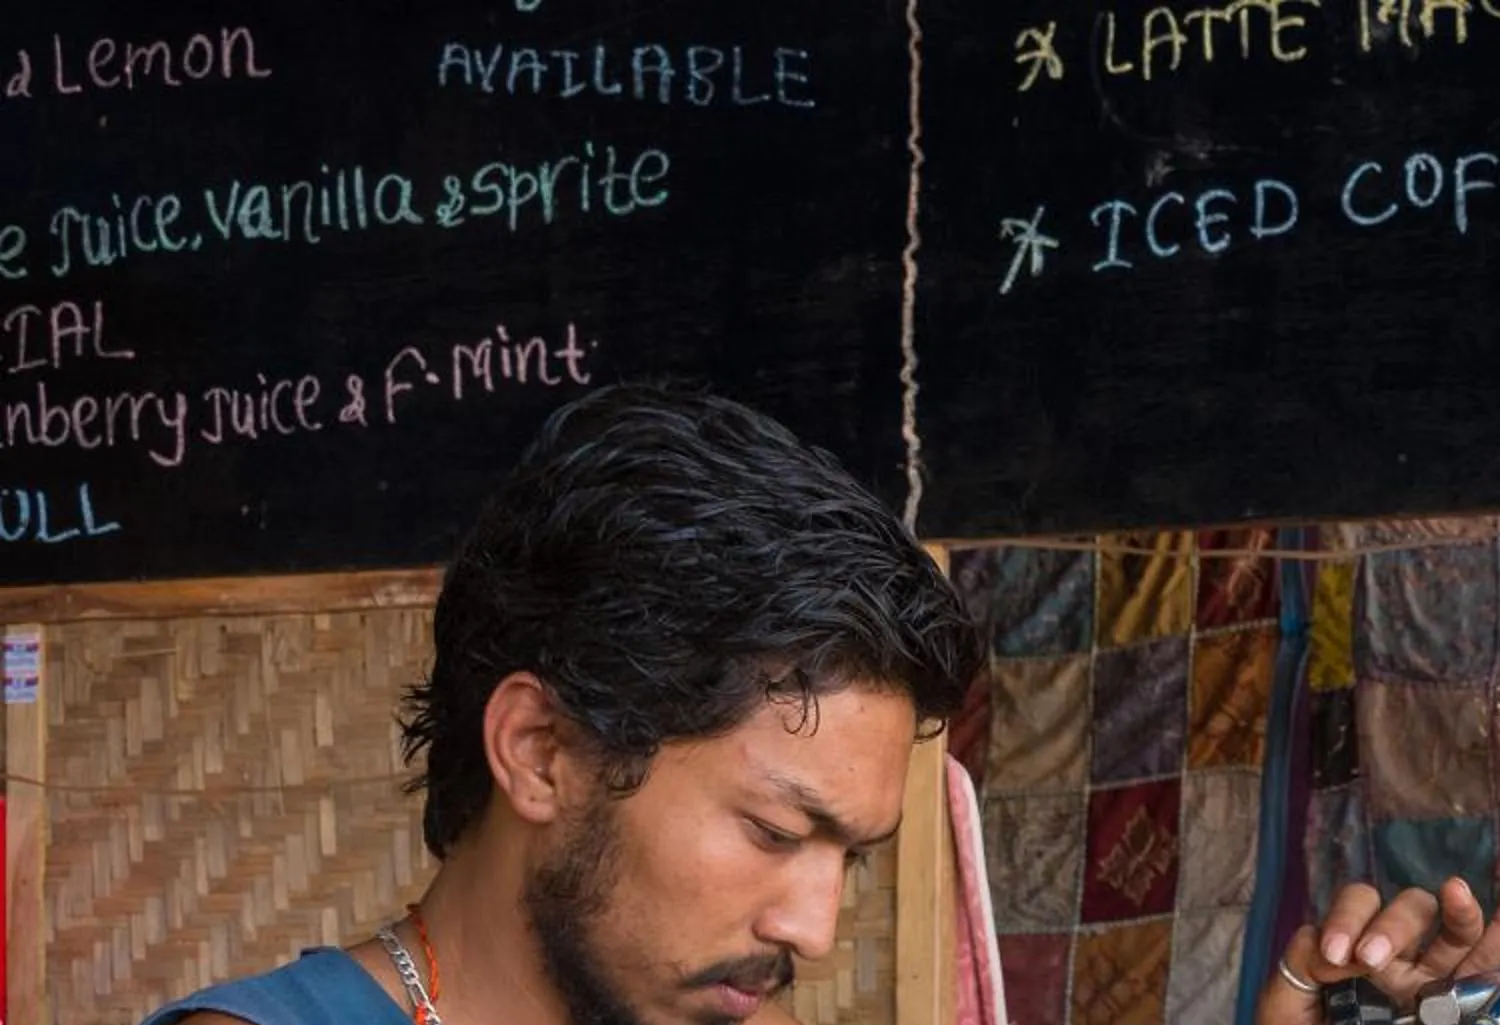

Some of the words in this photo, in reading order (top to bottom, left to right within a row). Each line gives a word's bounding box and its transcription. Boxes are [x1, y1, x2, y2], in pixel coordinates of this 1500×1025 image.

[53, 26, 273, 93] Lemon
[438, 43, 816, 108] AVAILABLE
[1104, 0, 1321, 81] LATTE
[1090, 179, 1299, 273] ICED
[0, 300, 136, 374] IAL
[0, 381, 188, 467] nberry
